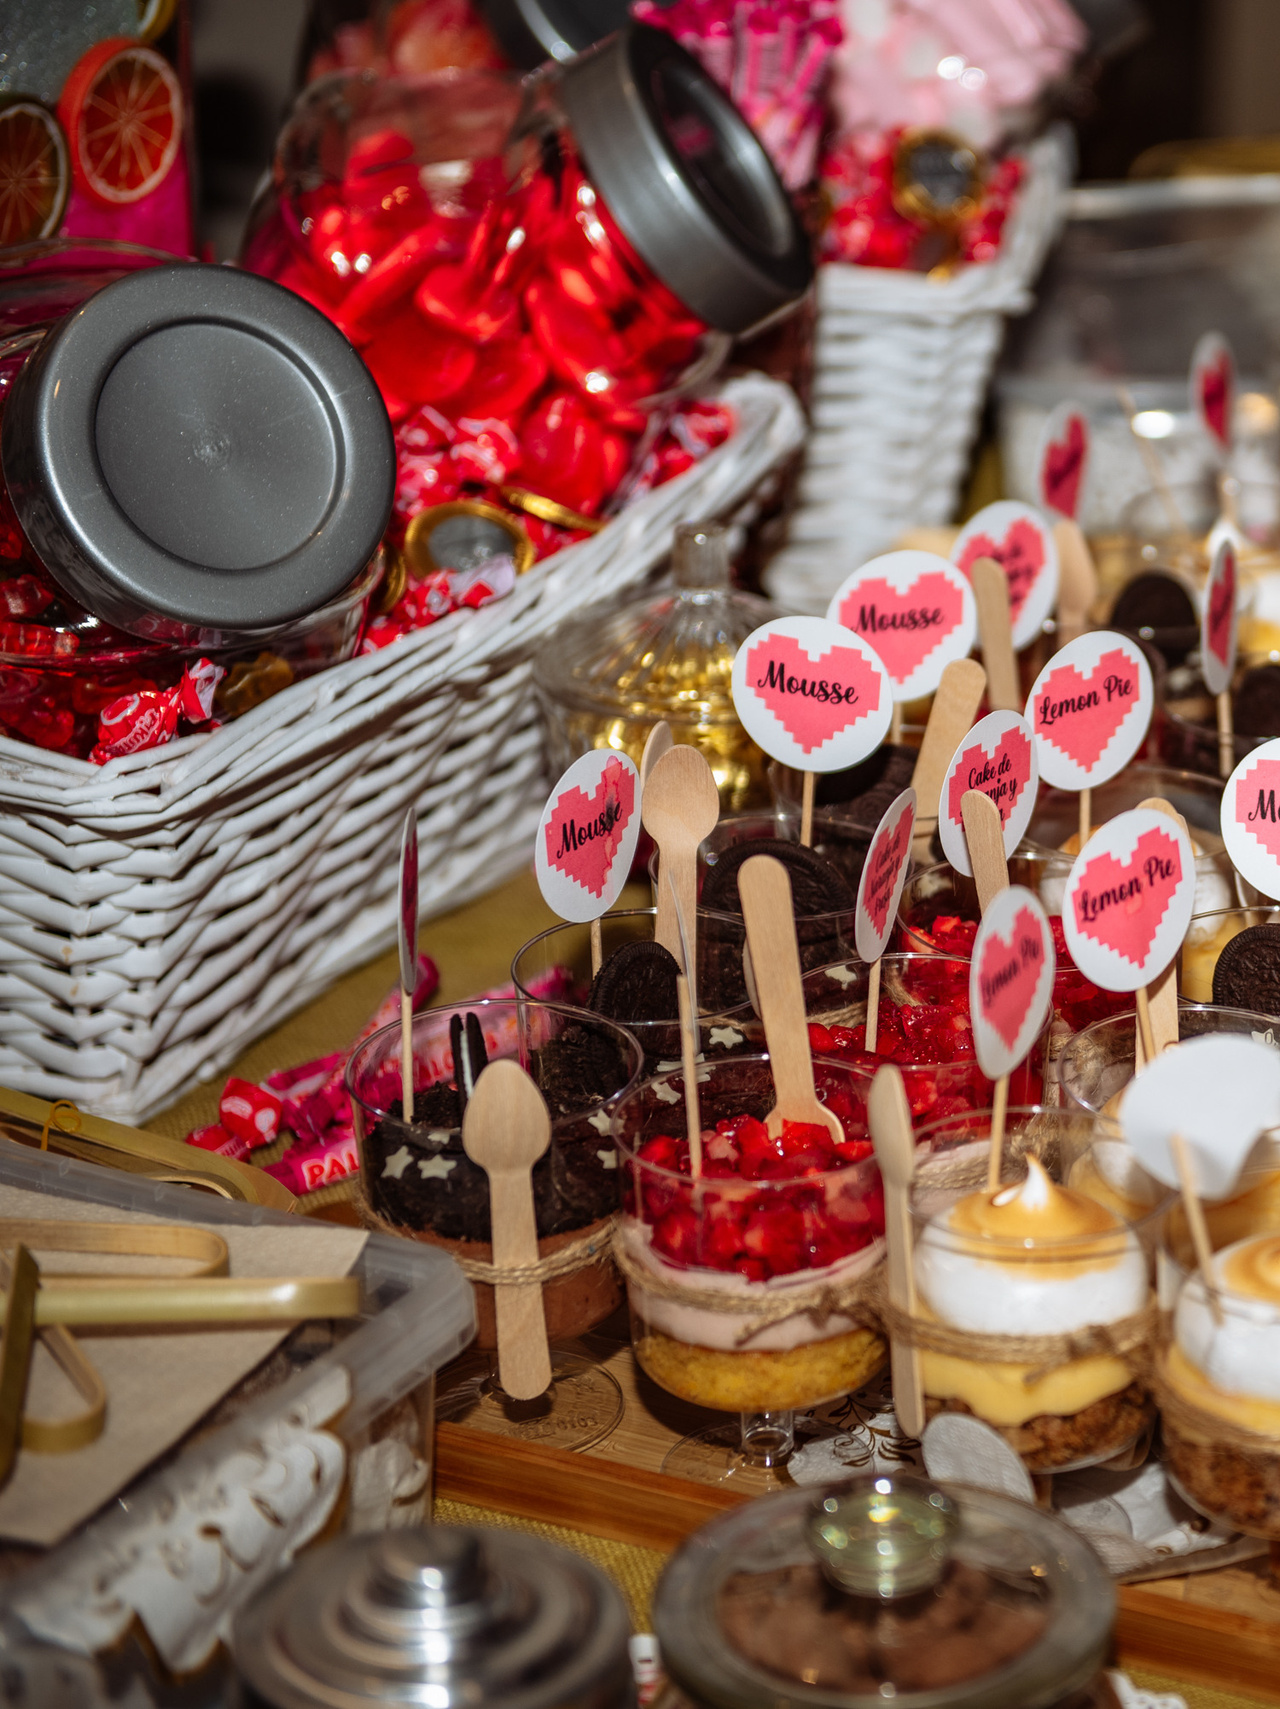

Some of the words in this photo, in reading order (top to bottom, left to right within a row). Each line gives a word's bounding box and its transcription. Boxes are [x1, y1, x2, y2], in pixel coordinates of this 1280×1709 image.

[850, 603, 945, 634] Mousse
[757, 660, 860, 705] Mousse
[1039, 696, 1101, 725] Lemon
[1103, 674, 1133, 702] Pie
[968, 761, 996, 790] Cake
[998, 752, 1012, 776] de
[556, 800, 623, 860] Mousse
[1078, 876, 1143, 923] Lemon
[1143, 855, 1176, 888] Pie
